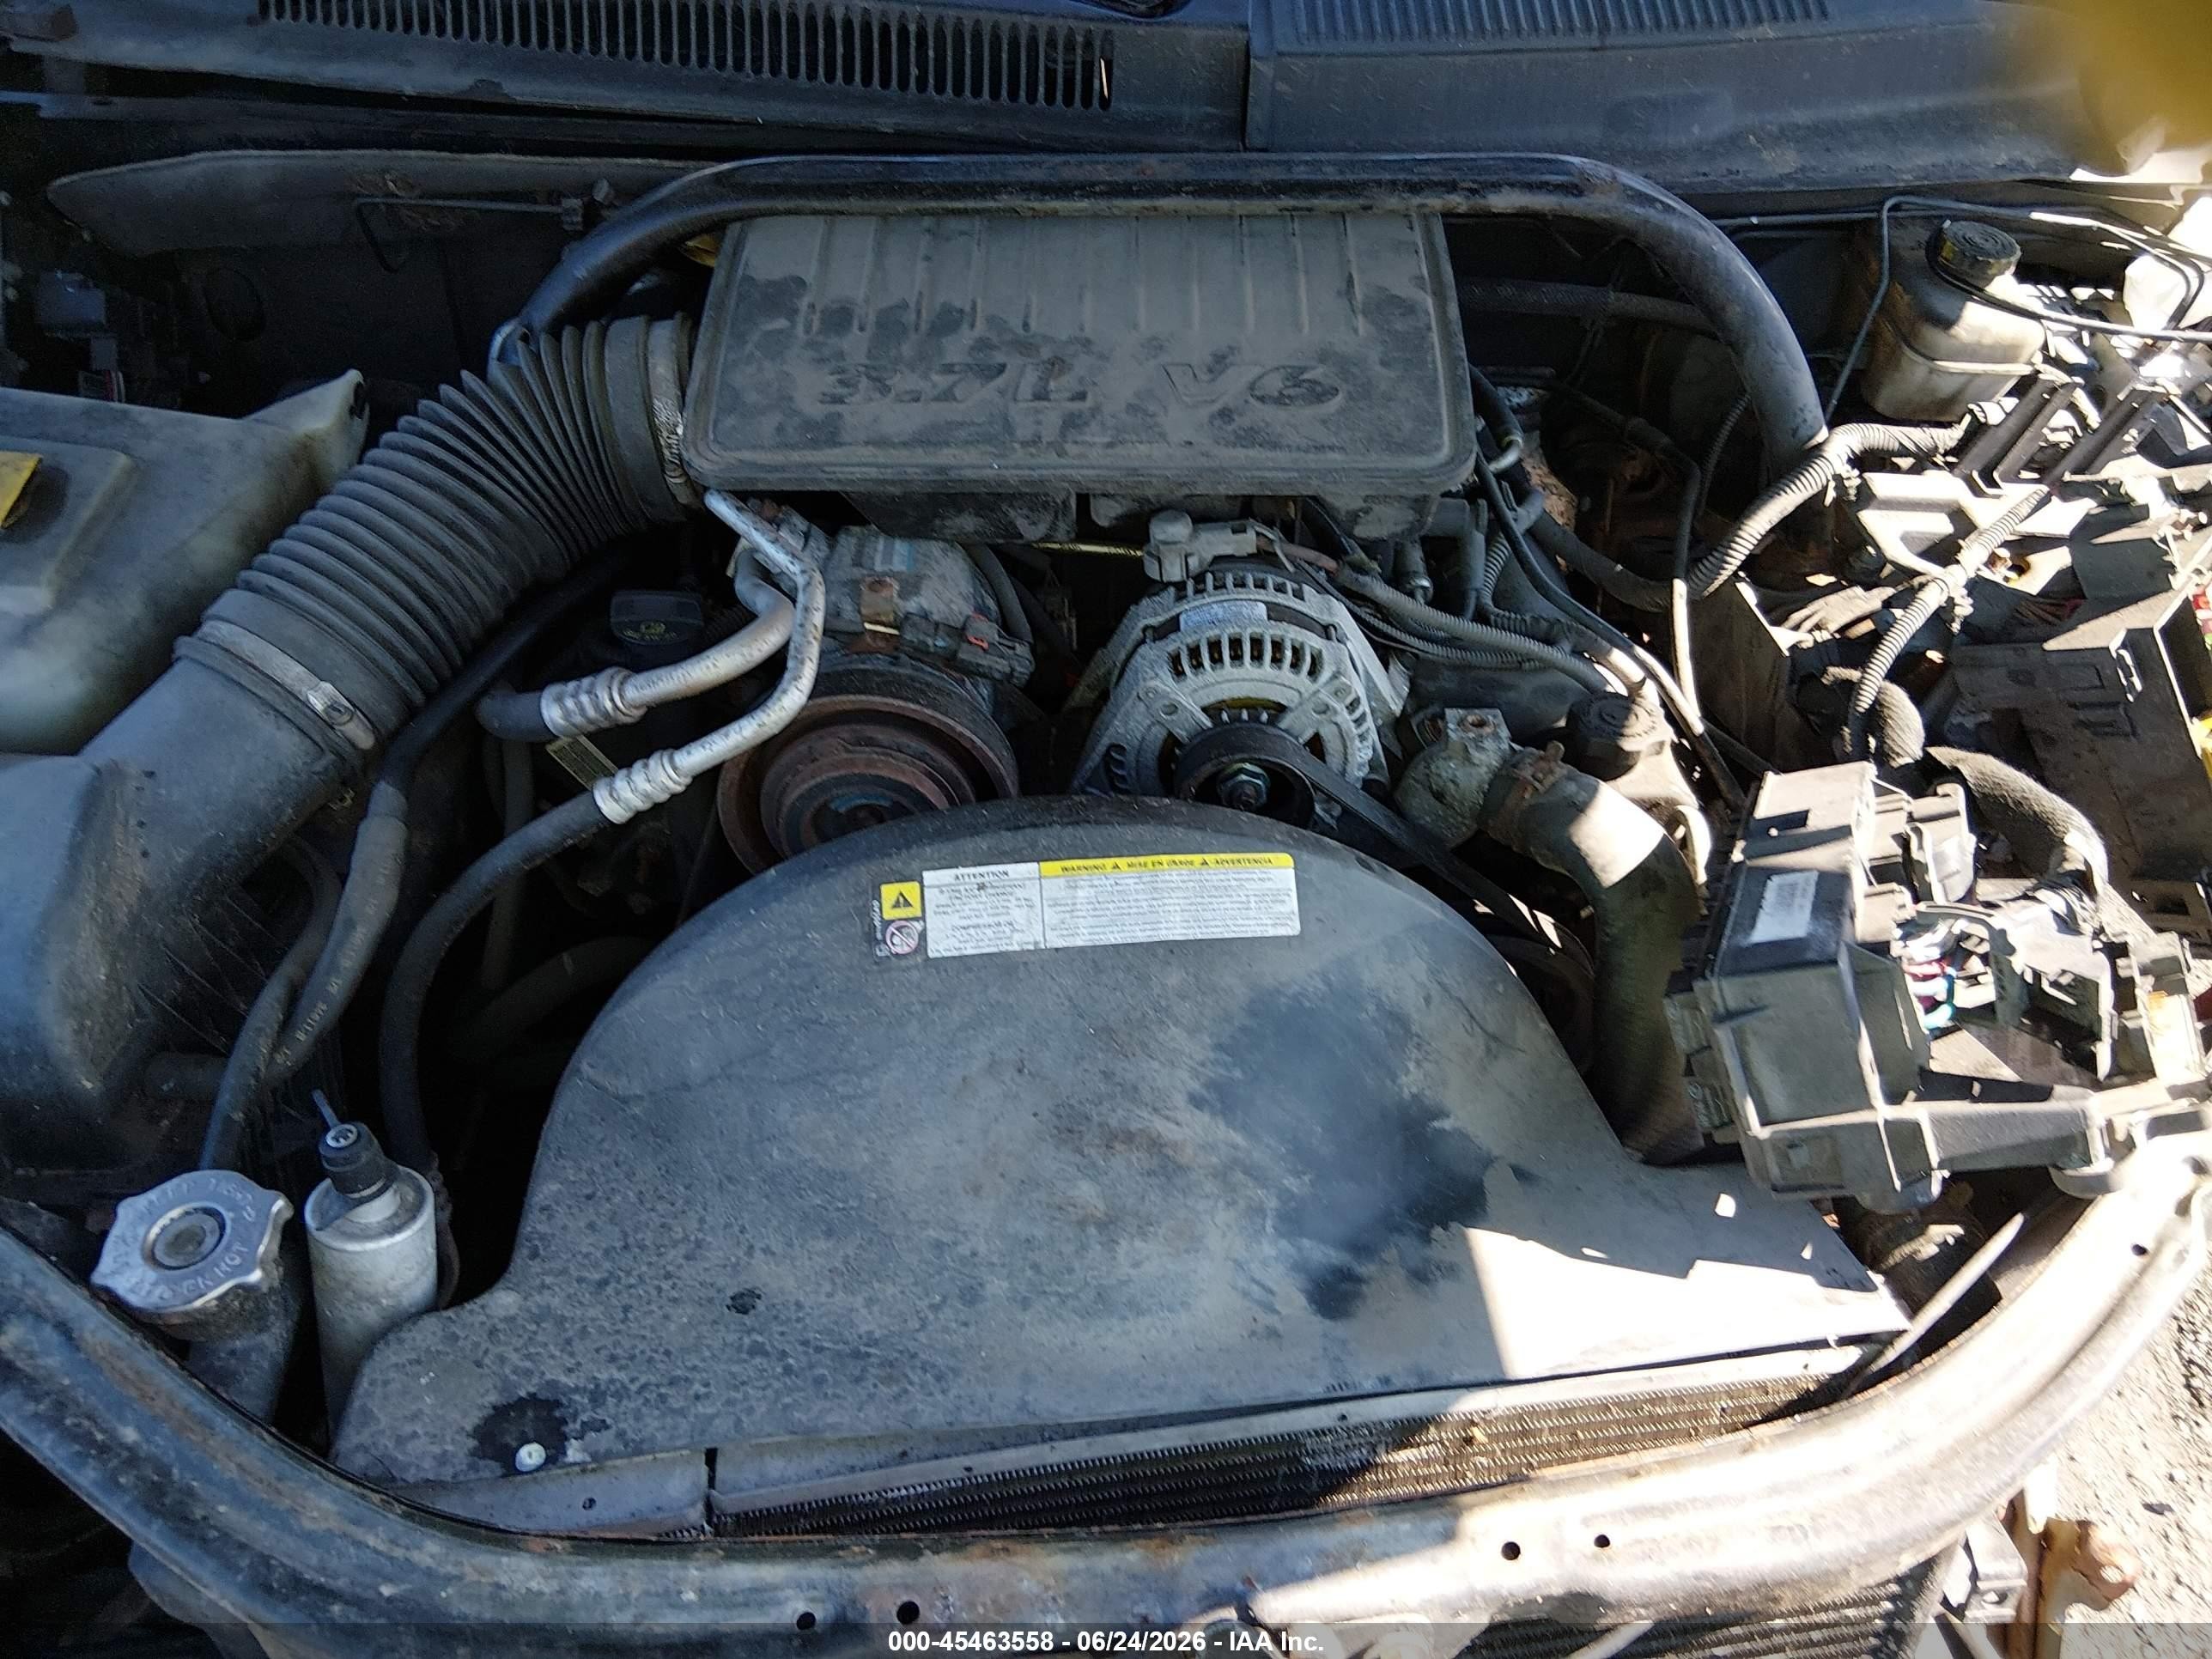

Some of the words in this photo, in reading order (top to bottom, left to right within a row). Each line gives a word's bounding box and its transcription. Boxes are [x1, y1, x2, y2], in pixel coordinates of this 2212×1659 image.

[1162, 362, 1345, 410] V6
[1060, 862, 1107, 873] WARNING
[1127, 860, 1149, 871] MISE
[1151, 860, 1164, 870] EN
[1215, 856, 1273, 868] ADVERTENCIA
[953, 868, 1010, 882] ATTENTION
